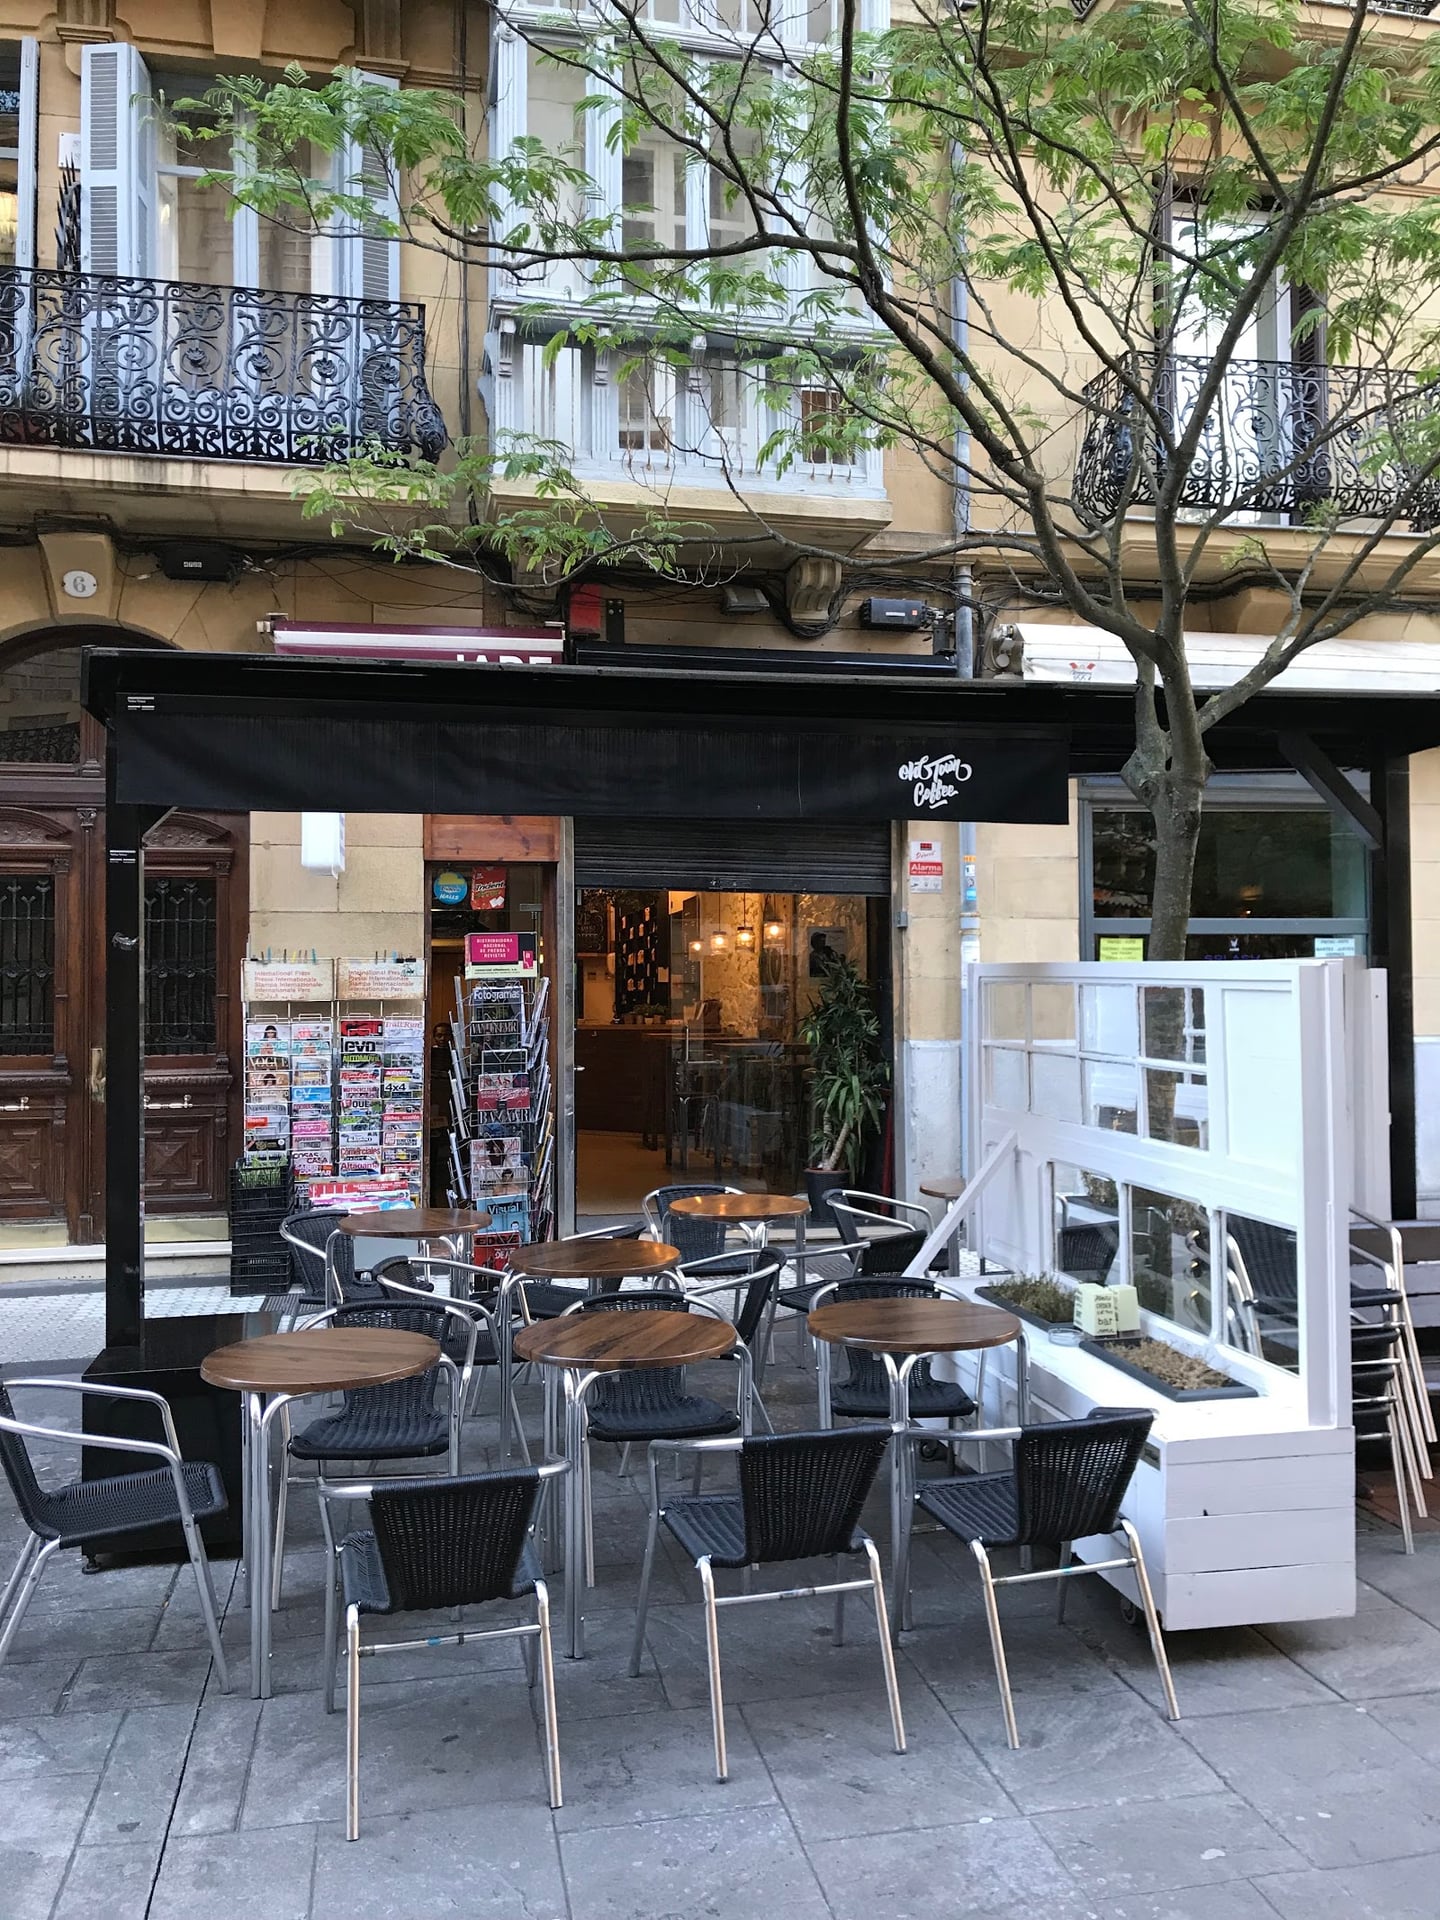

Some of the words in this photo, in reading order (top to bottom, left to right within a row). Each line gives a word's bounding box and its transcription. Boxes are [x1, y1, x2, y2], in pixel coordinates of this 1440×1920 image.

[72, 575, 87, 593] 6
[911, 863, 942, 872] Alarma
[473, 989, 520, 1002] Fotogramas
[344, 1040, 376, 1052] evo
[384, 1083, 406, 1091] 4x4
[340, 1146, 380, 1155] Comerciales
[487, 1203, 520, 1214] Visual
